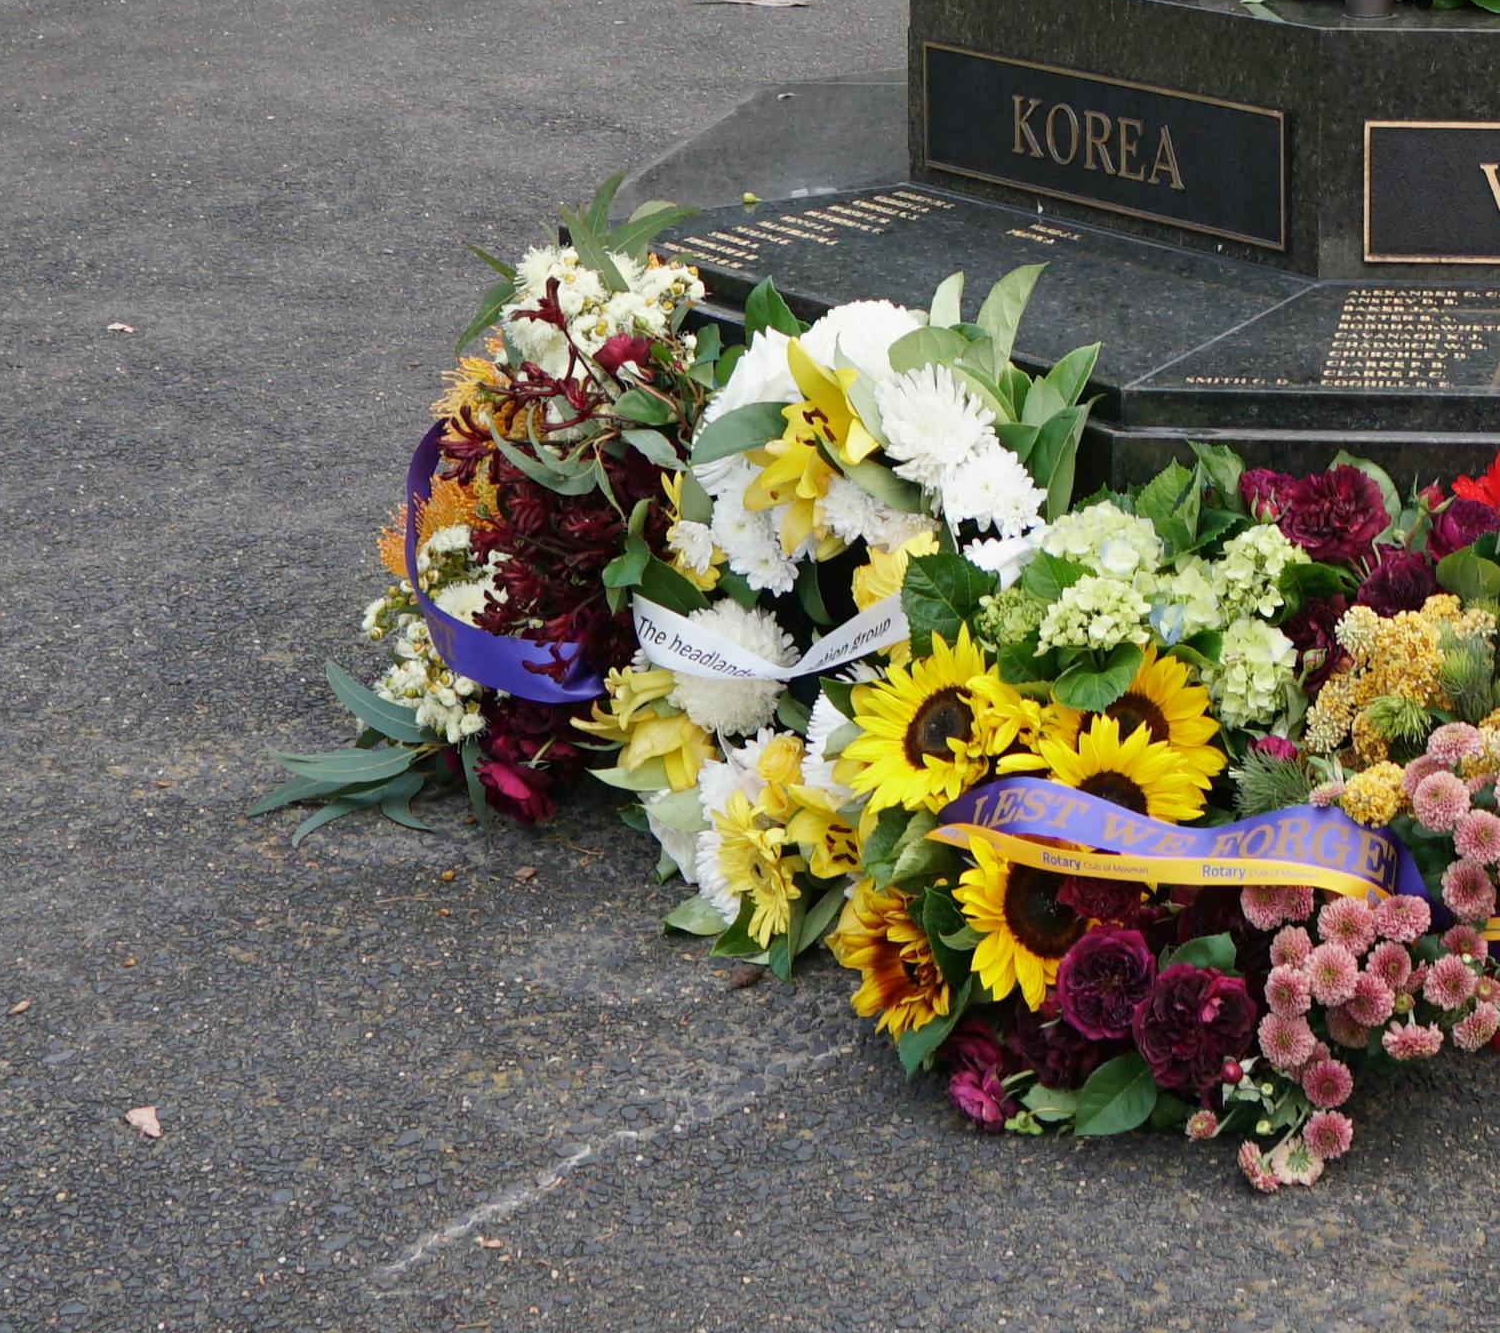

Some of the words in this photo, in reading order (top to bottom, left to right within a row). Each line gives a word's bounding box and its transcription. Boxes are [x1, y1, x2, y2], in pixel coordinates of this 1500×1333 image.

[1009, 92, 1187, 193] KOREA
[637, 615, 667, 646] The
[850, 616, 892, 654] group
[972, 786, 1091, 830] LEST
[1099, 814, 1195, 858] WE
[1042, 851, 1082, 871] Rotary
[1201, 863, 1246, 881] Rotary
